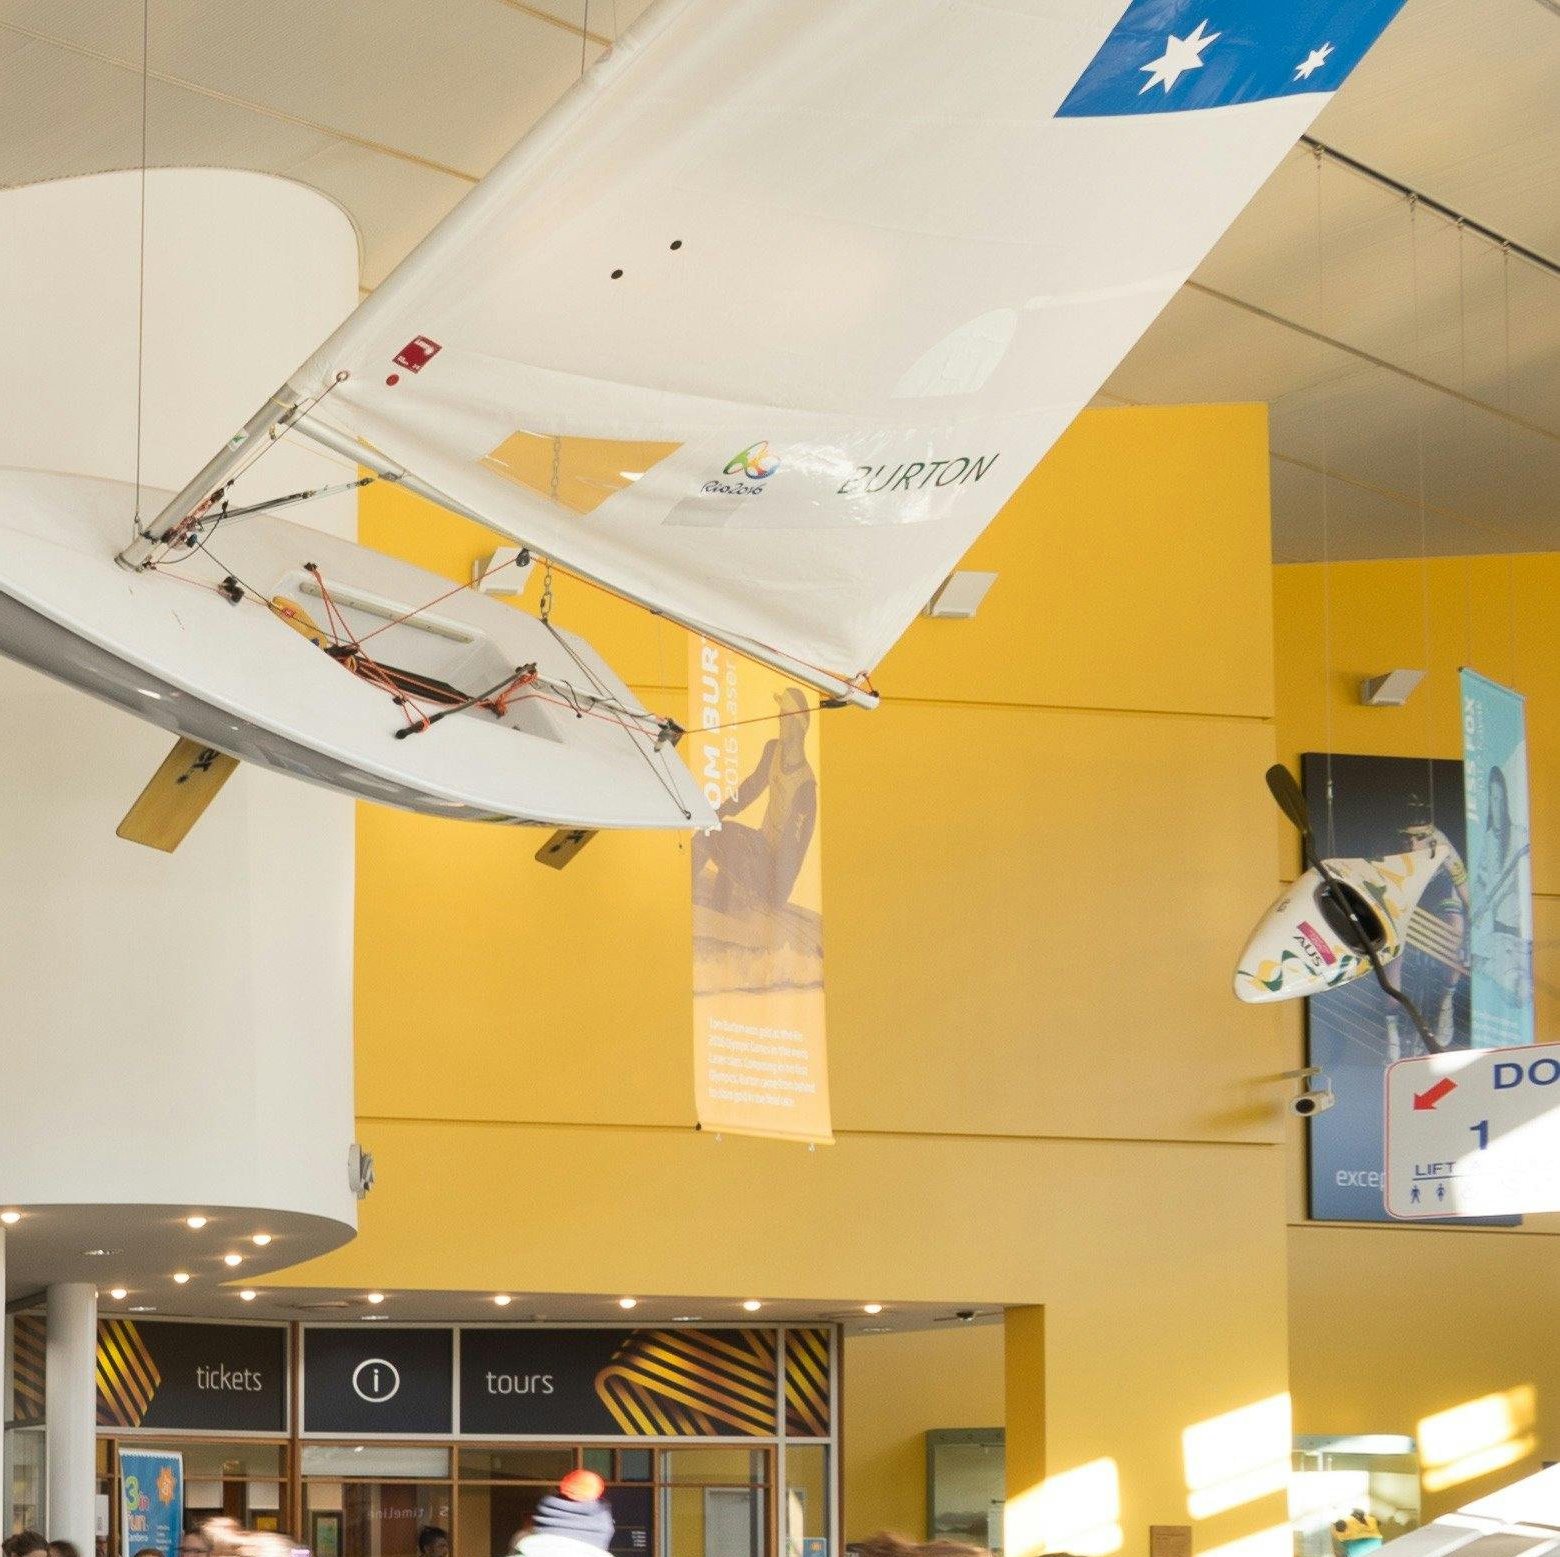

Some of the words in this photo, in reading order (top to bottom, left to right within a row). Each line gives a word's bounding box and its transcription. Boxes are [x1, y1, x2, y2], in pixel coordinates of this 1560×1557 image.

[837, 453, 1000, 495] BURTON
[701, 637, 721, 734] BUR
[1470, 1120, 1489, 1150] 1
[196, 1365, 263, 1392] tickets
[486, 1371, 555, 1395] tours
